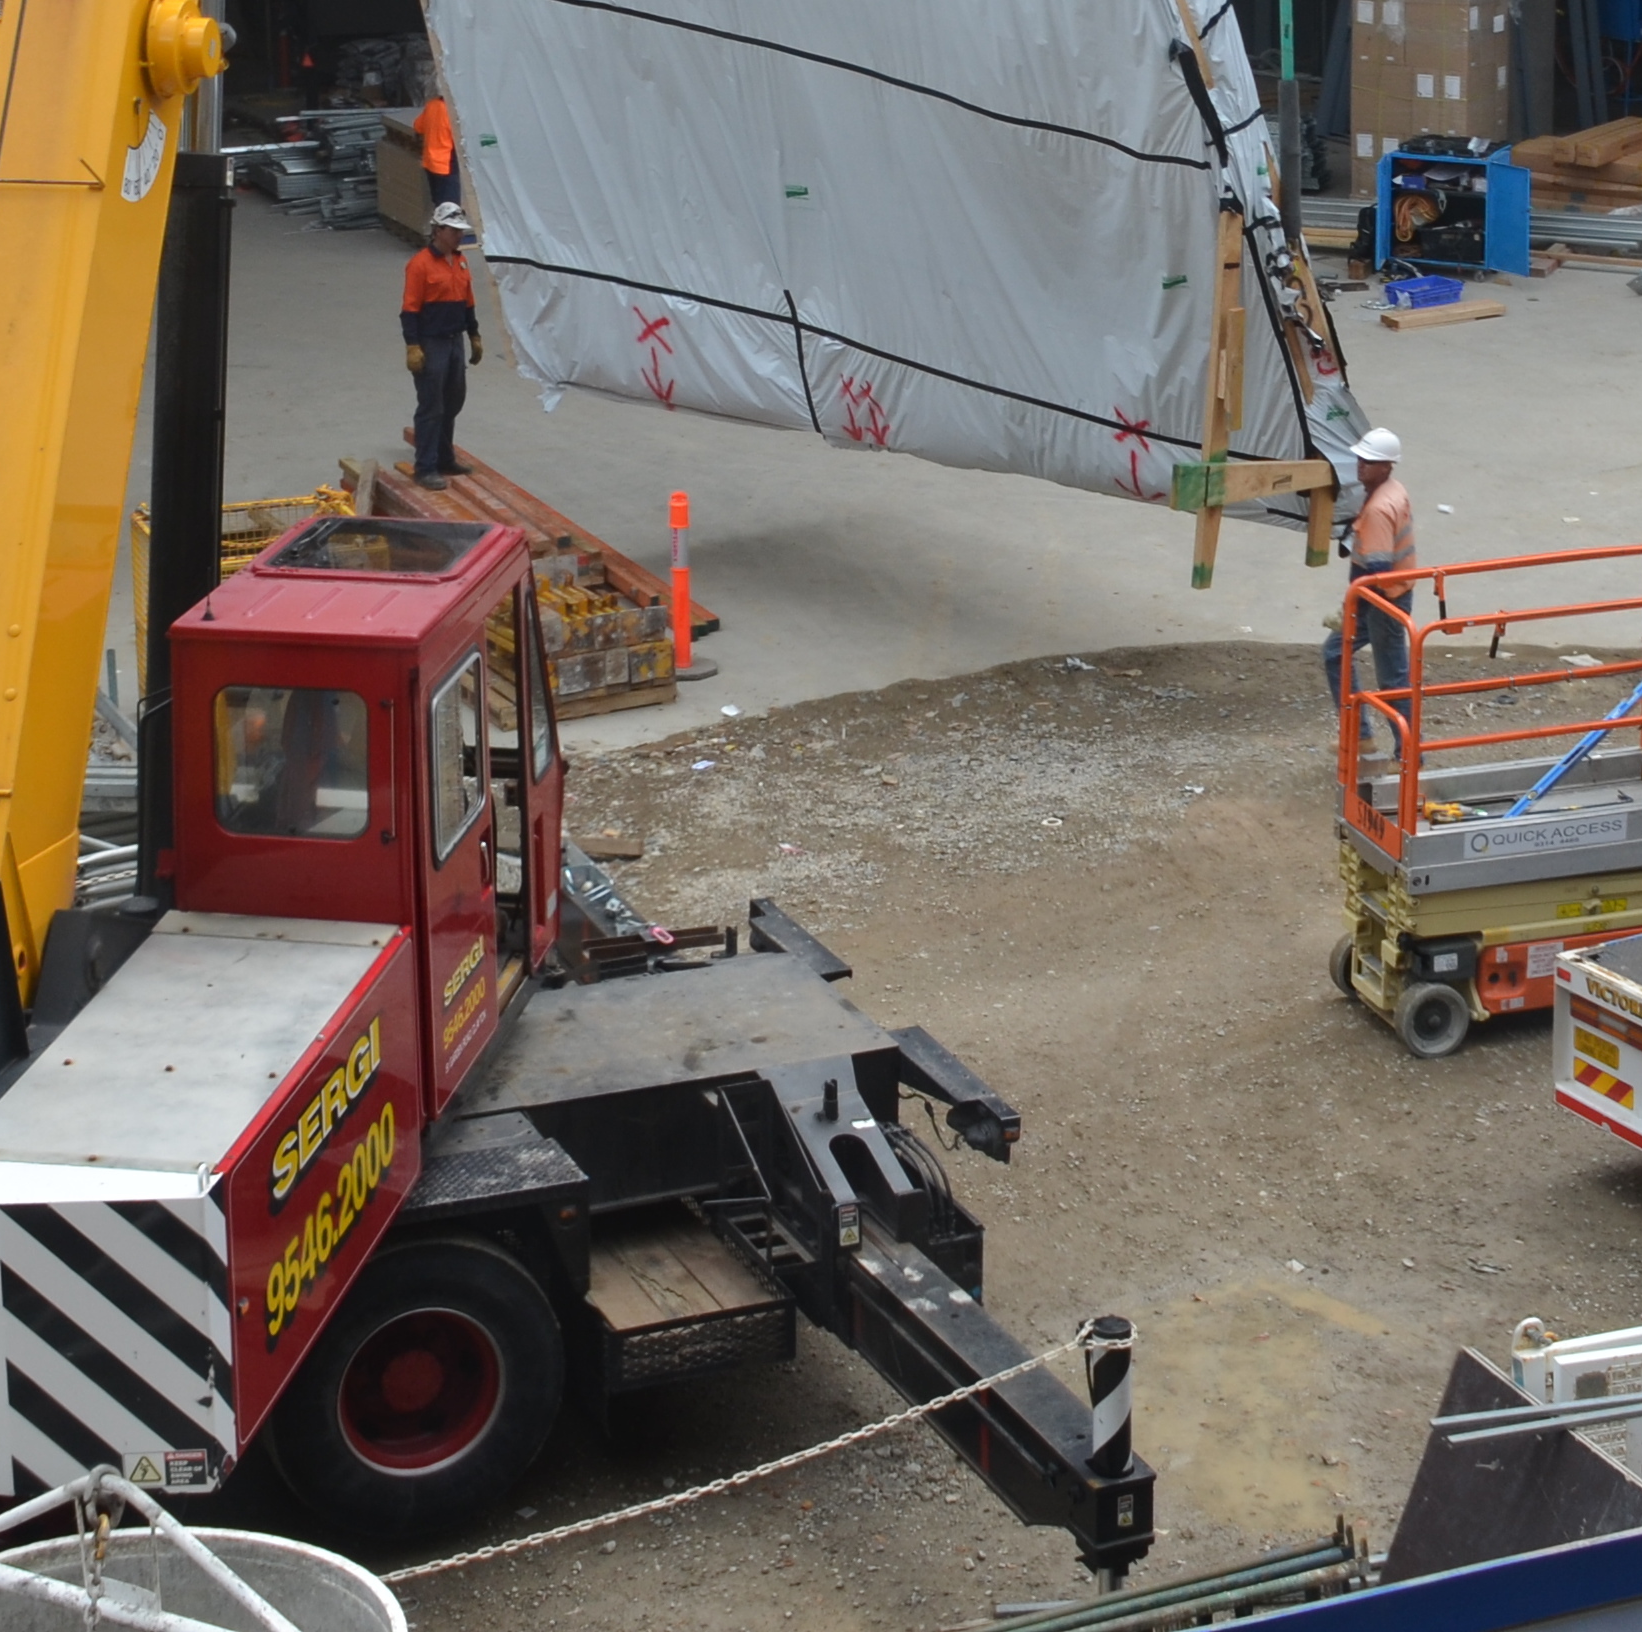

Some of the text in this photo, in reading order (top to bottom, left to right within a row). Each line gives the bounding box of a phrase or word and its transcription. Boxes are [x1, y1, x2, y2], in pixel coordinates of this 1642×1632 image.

[1492, 819, 1623, 846] QUICK ACCESS
[444, 933, 485, 1008] SERGI
[443, 975, 486, 1051] 9546.2000
[272, 1016, 382, 1202] SERGI
[265, 1101, 395, 1336] 9546.2000
